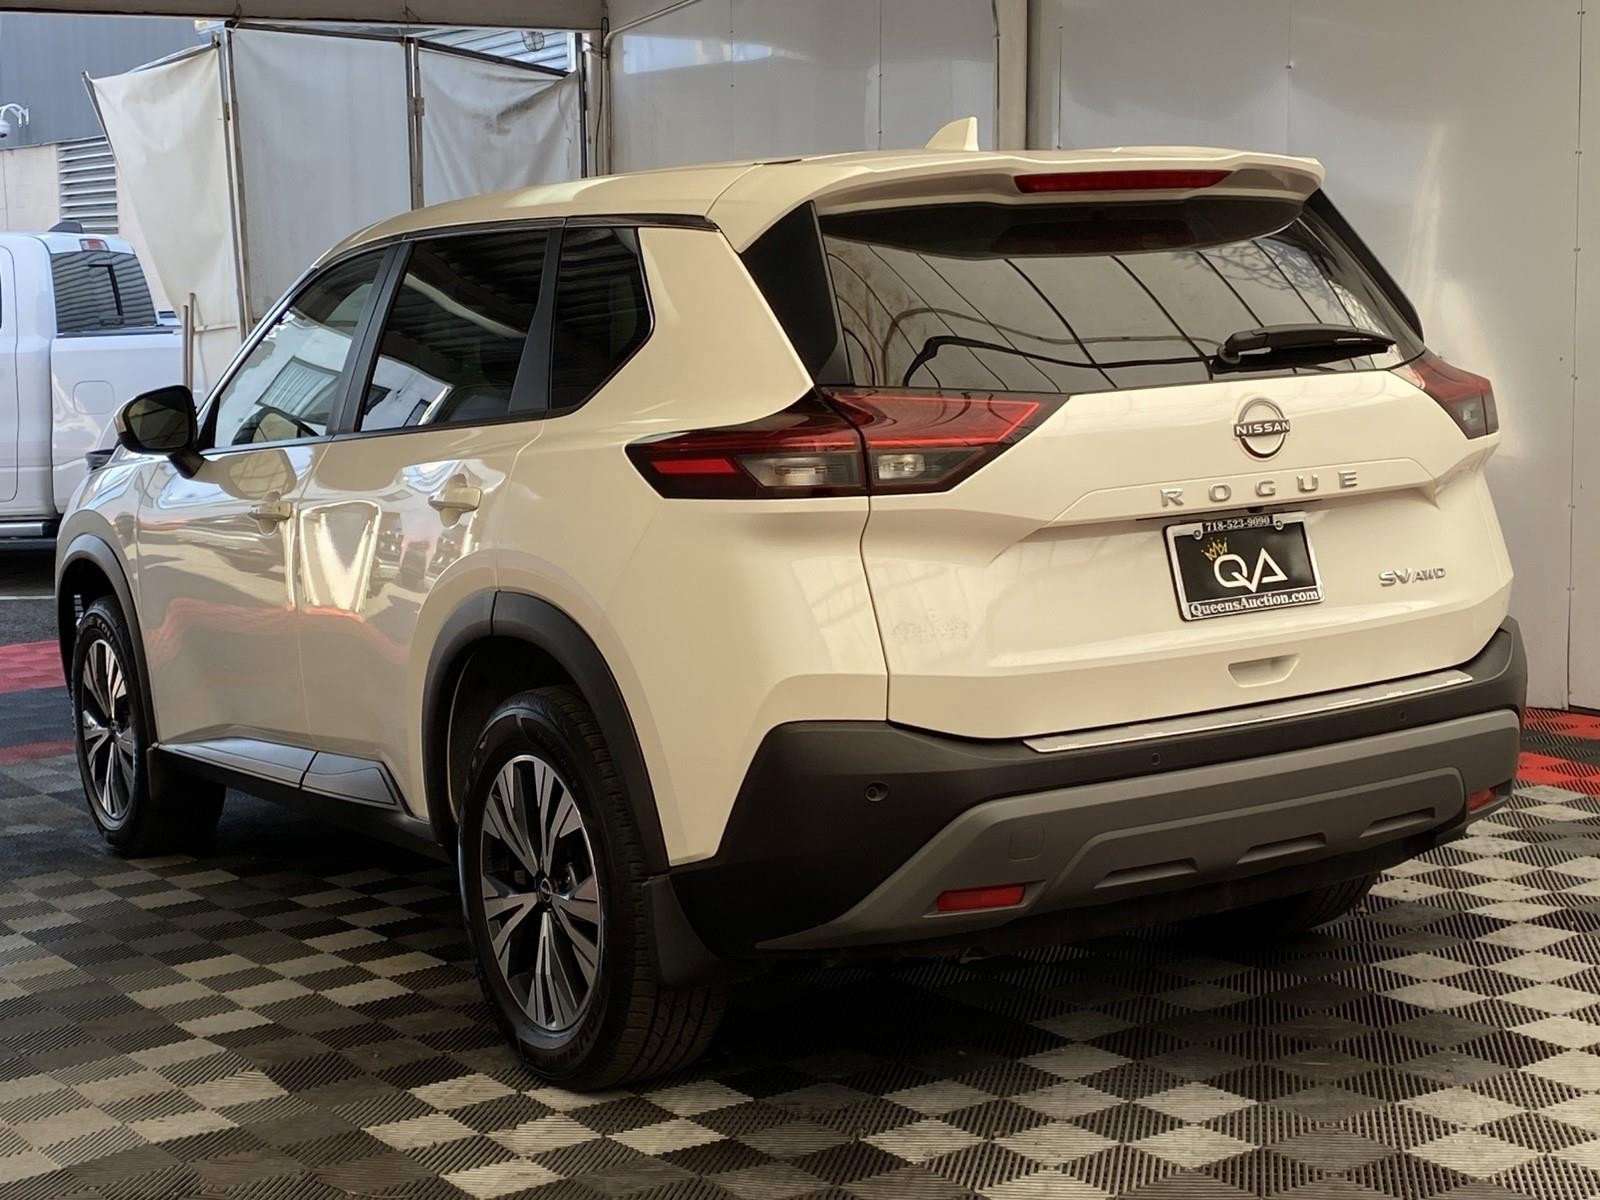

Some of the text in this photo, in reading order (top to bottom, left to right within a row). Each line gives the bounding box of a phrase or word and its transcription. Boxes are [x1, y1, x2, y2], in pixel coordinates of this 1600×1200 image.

[1236, 421, 1290, 435] NISSAN
[1160, 470, 1358, 508] ROGUE
[1205, 515, 1271, 532] 718-523-9090
[1378, 567, 1446, 588] SV AWD
[1190, 589, 1320, 616] QueensAuction.com
